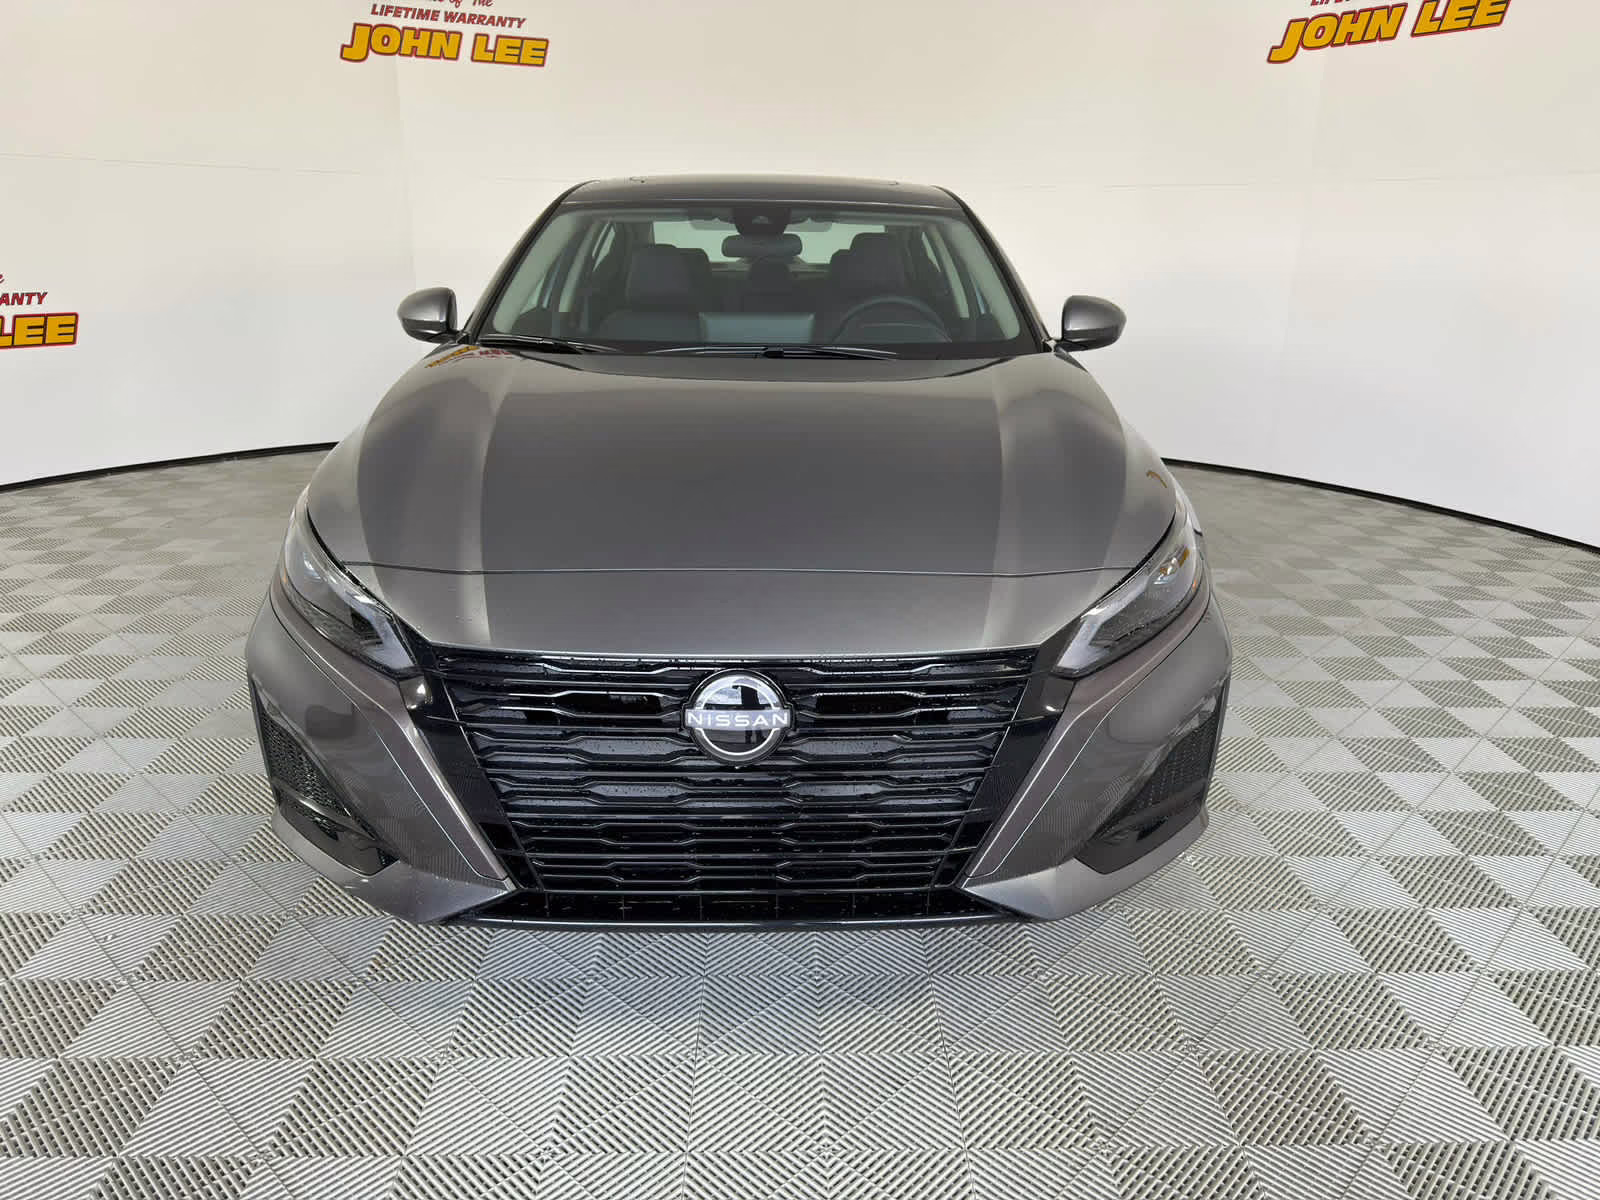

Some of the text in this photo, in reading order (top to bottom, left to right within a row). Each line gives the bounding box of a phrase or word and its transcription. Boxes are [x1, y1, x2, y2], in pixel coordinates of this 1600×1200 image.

[371, 4, 527, 29] LIFETIME WARRANTY
[1267, 0, 1511, 64] JOHN LEE
[340, 22, 550, 67] JOHN LEE
[687, 712, 788, 727] NISSAN
